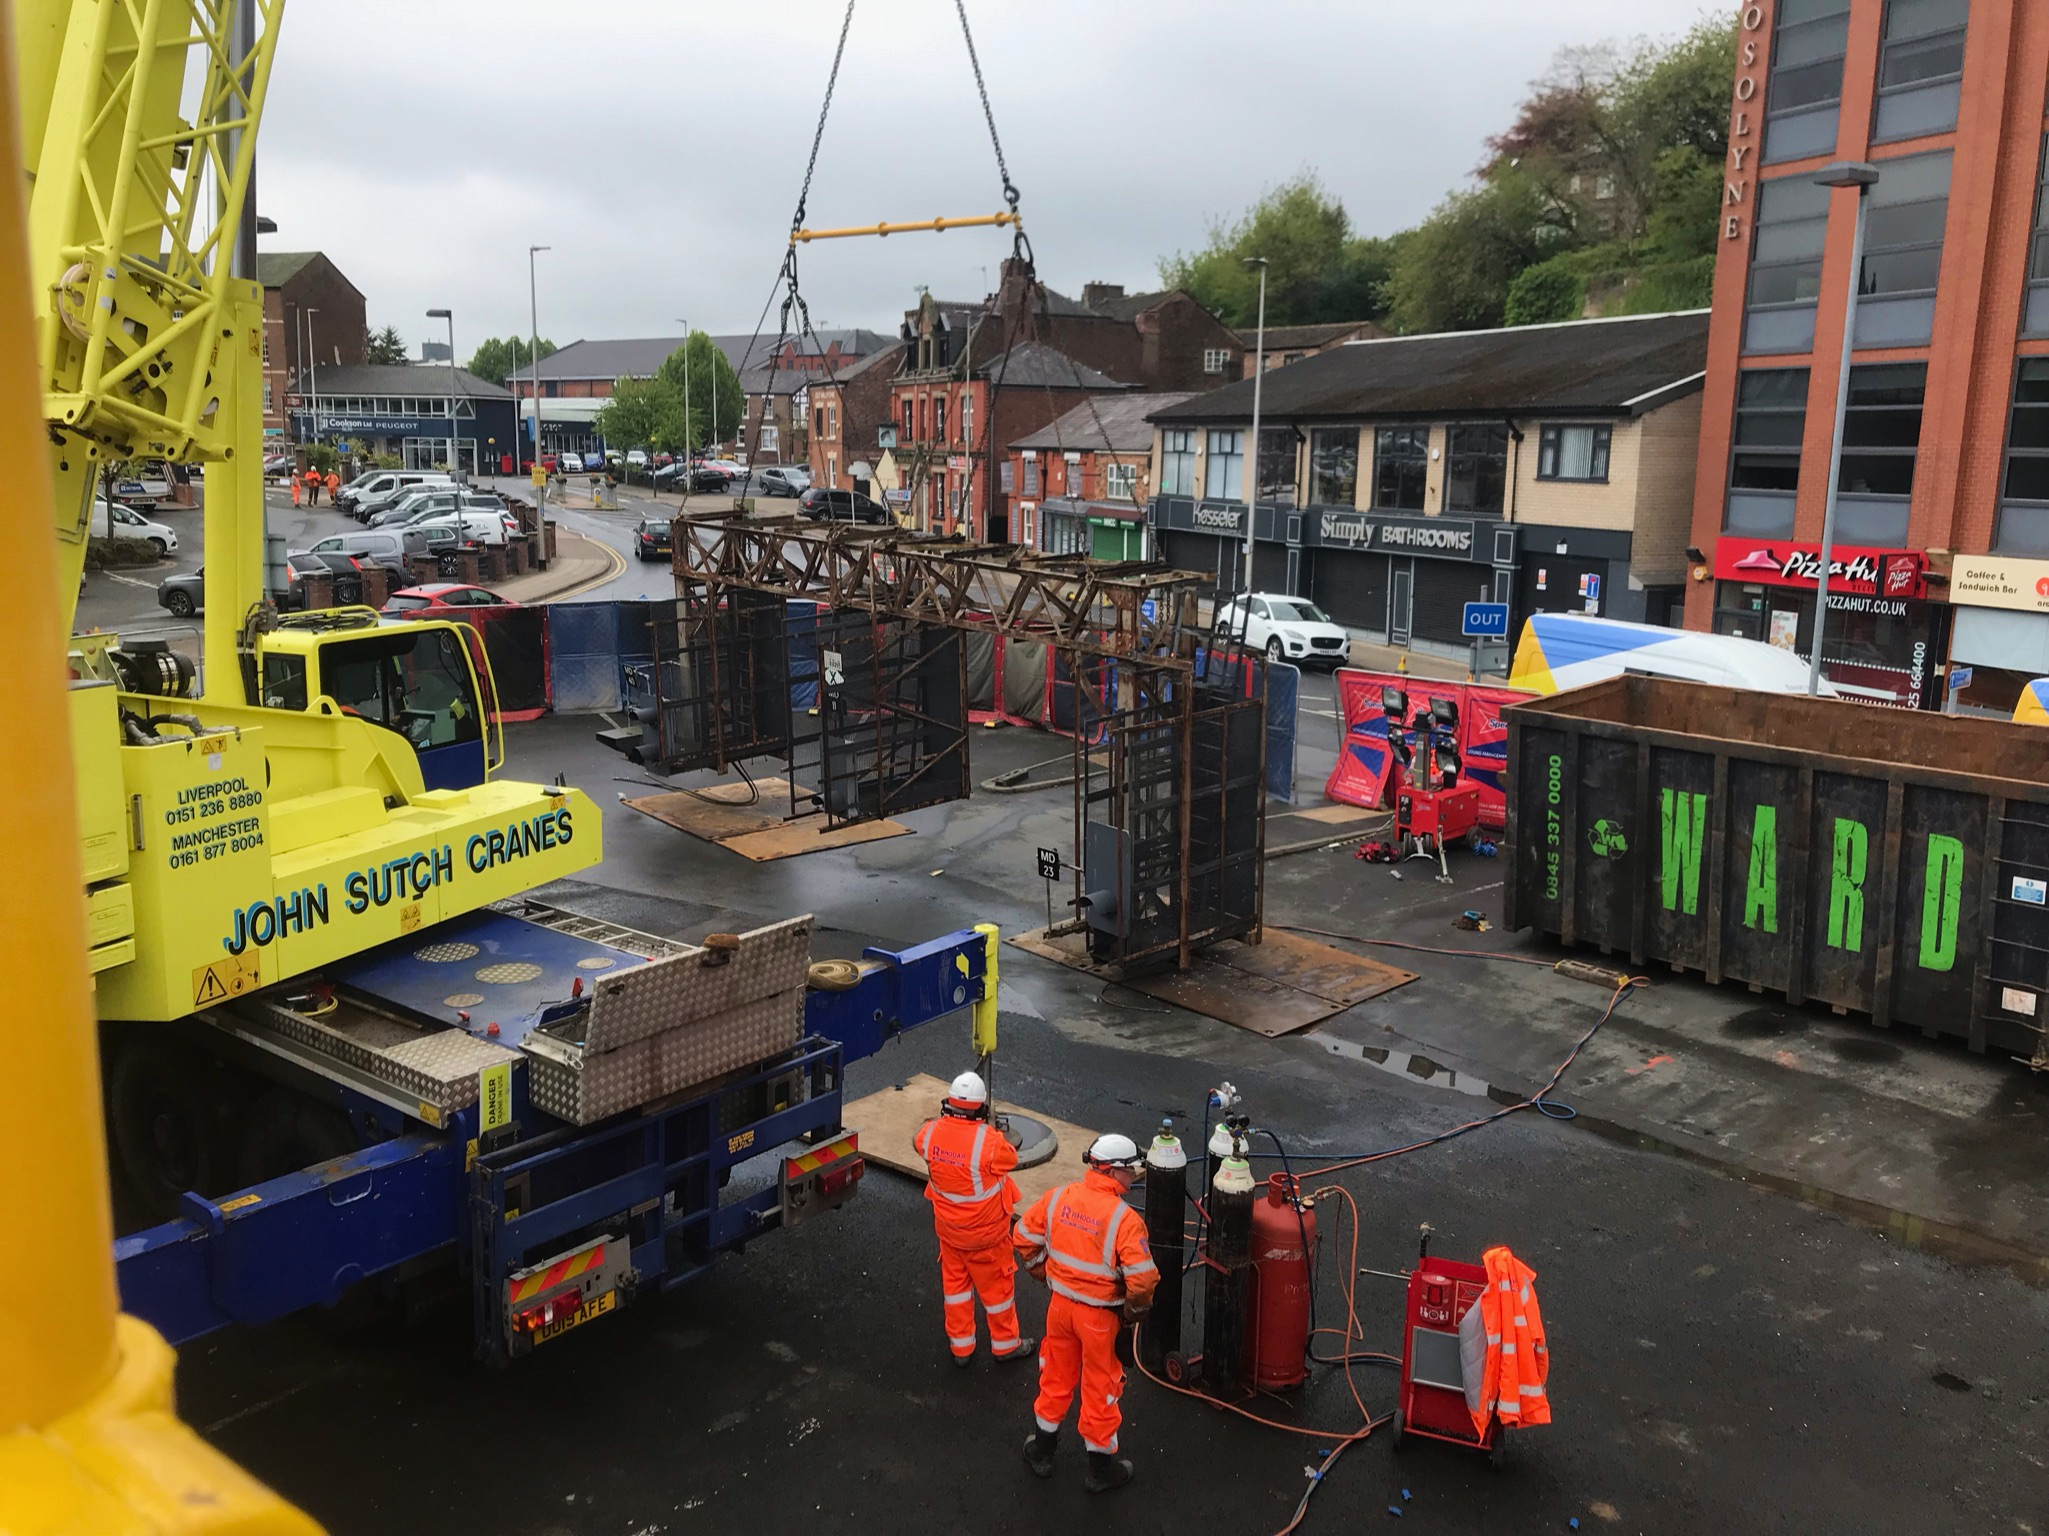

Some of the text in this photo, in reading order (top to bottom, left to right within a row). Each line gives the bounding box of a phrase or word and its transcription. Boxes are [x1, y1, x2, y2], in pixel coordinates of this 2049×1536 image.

[1725, 0, 1762, 239] OSOLYNE
[329, 418, 362, 428] Cookson
[375, 422, 419, 430] PEUGEOT
[1321, 514, 1471, 550] Simply BATHROOMS
[1887, 570, 1911, 584] Pizza
[1891, 579, 1909, 592] Hut
[1958, 581, 2018, 594] Sandwich Bar
[1966, 570, 2005, 581] Coffee &
[1470, 612, 1502, 626] OUT
[1910, 641, 1926, 690] 664400
[177, 777, 249, 805] LIVERPOOL
[165, 790, 263, 826] 0151 236 8880
[171, 816, 260, 852] MANCHESTER
[1546, 754, 1563, 900] 0845 337 0000
[169, 832, 264, 870] 0161 877 8004
[1040, 850, 1056, 864] MD
[223, 807, 574, 956] JOHN SUTCH CRANES
[1043, 864, 1054, 878] 23
[1661, 787, 1965, 973] WARD
[488, 1078, 496, 1125] DANGER
[1071, 1210, 1102, 1227] RHODAR
[580, 1294, 608, 1322] AFE
